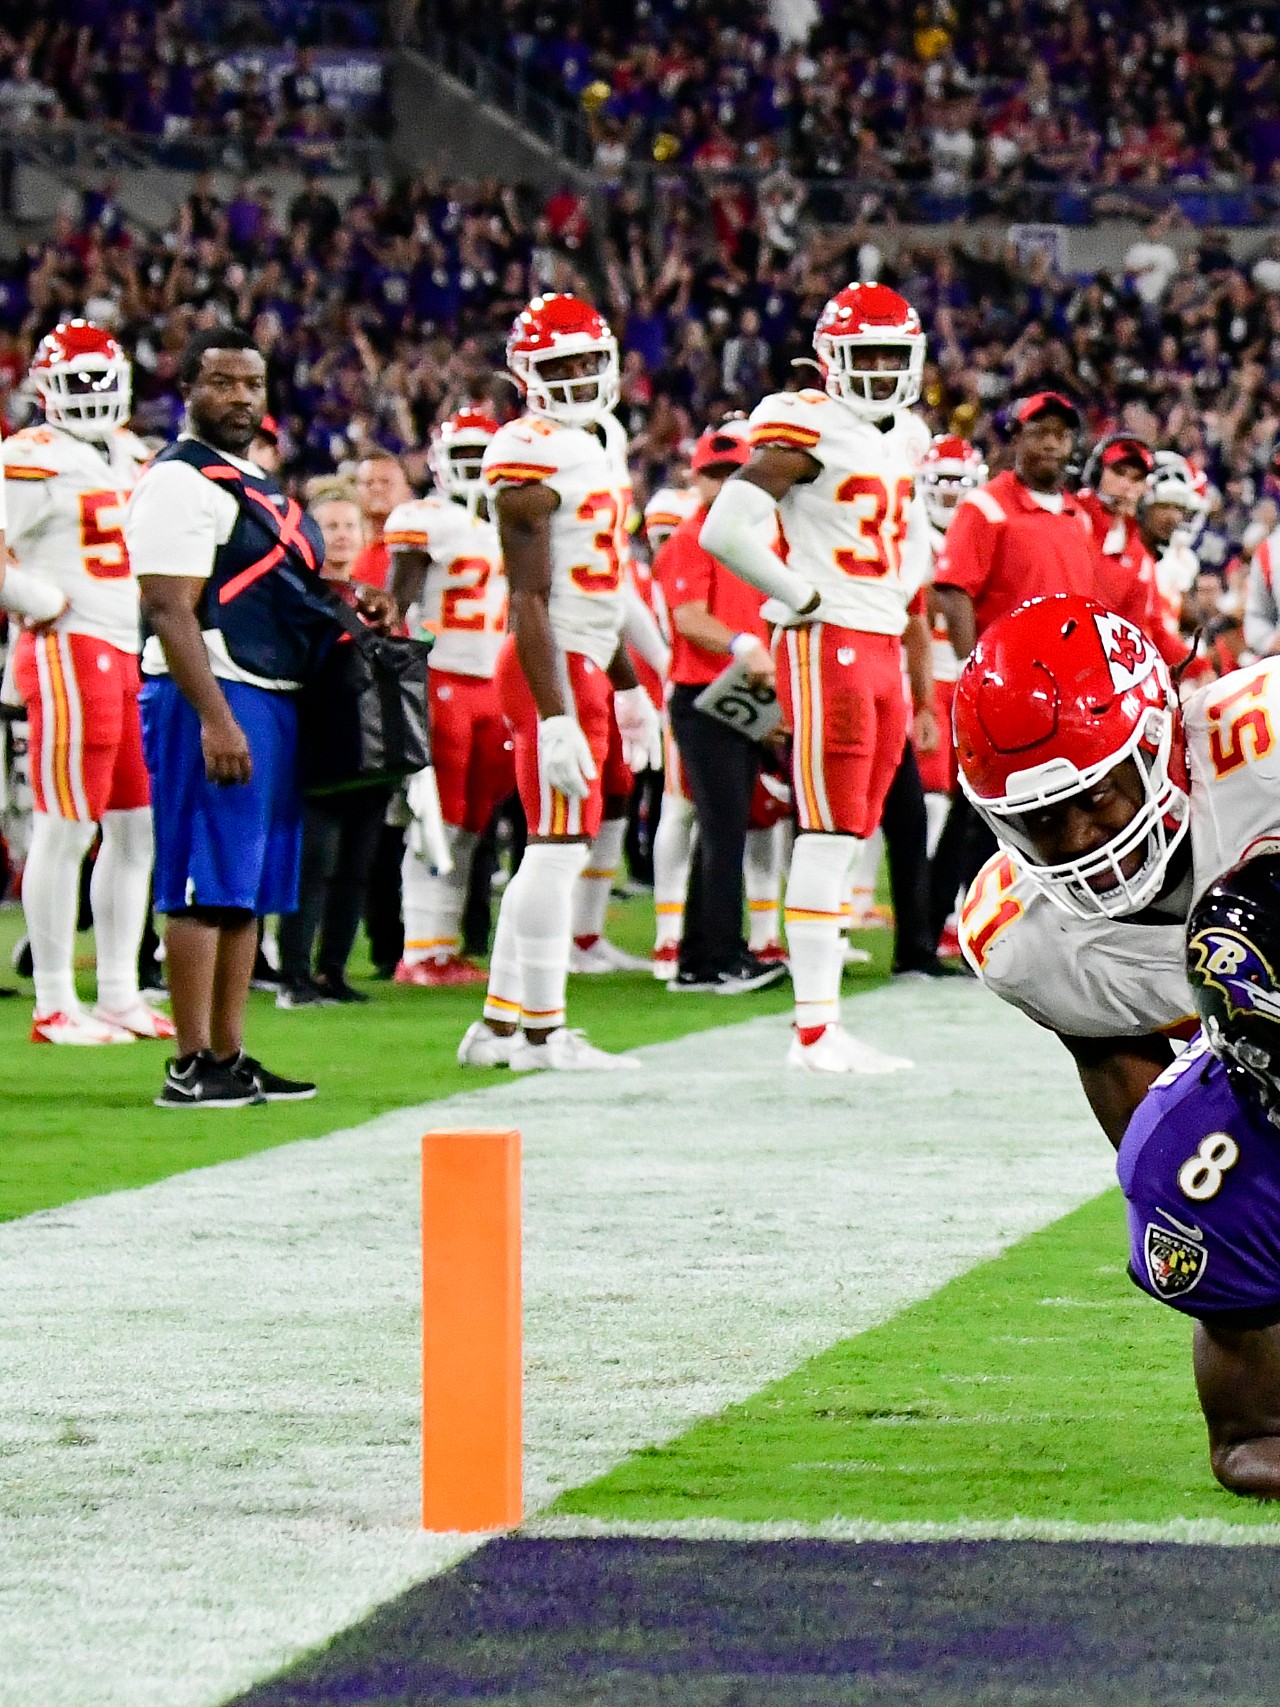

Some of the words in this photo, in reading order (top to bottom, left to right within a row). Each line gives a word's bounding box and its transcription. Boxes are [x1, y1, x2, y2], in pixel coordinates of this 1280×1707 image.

[77, 488, 134, 580] 5
[1207, 672, 1276, 782] 51
[1177, 1130, 1240, 1202] 8
